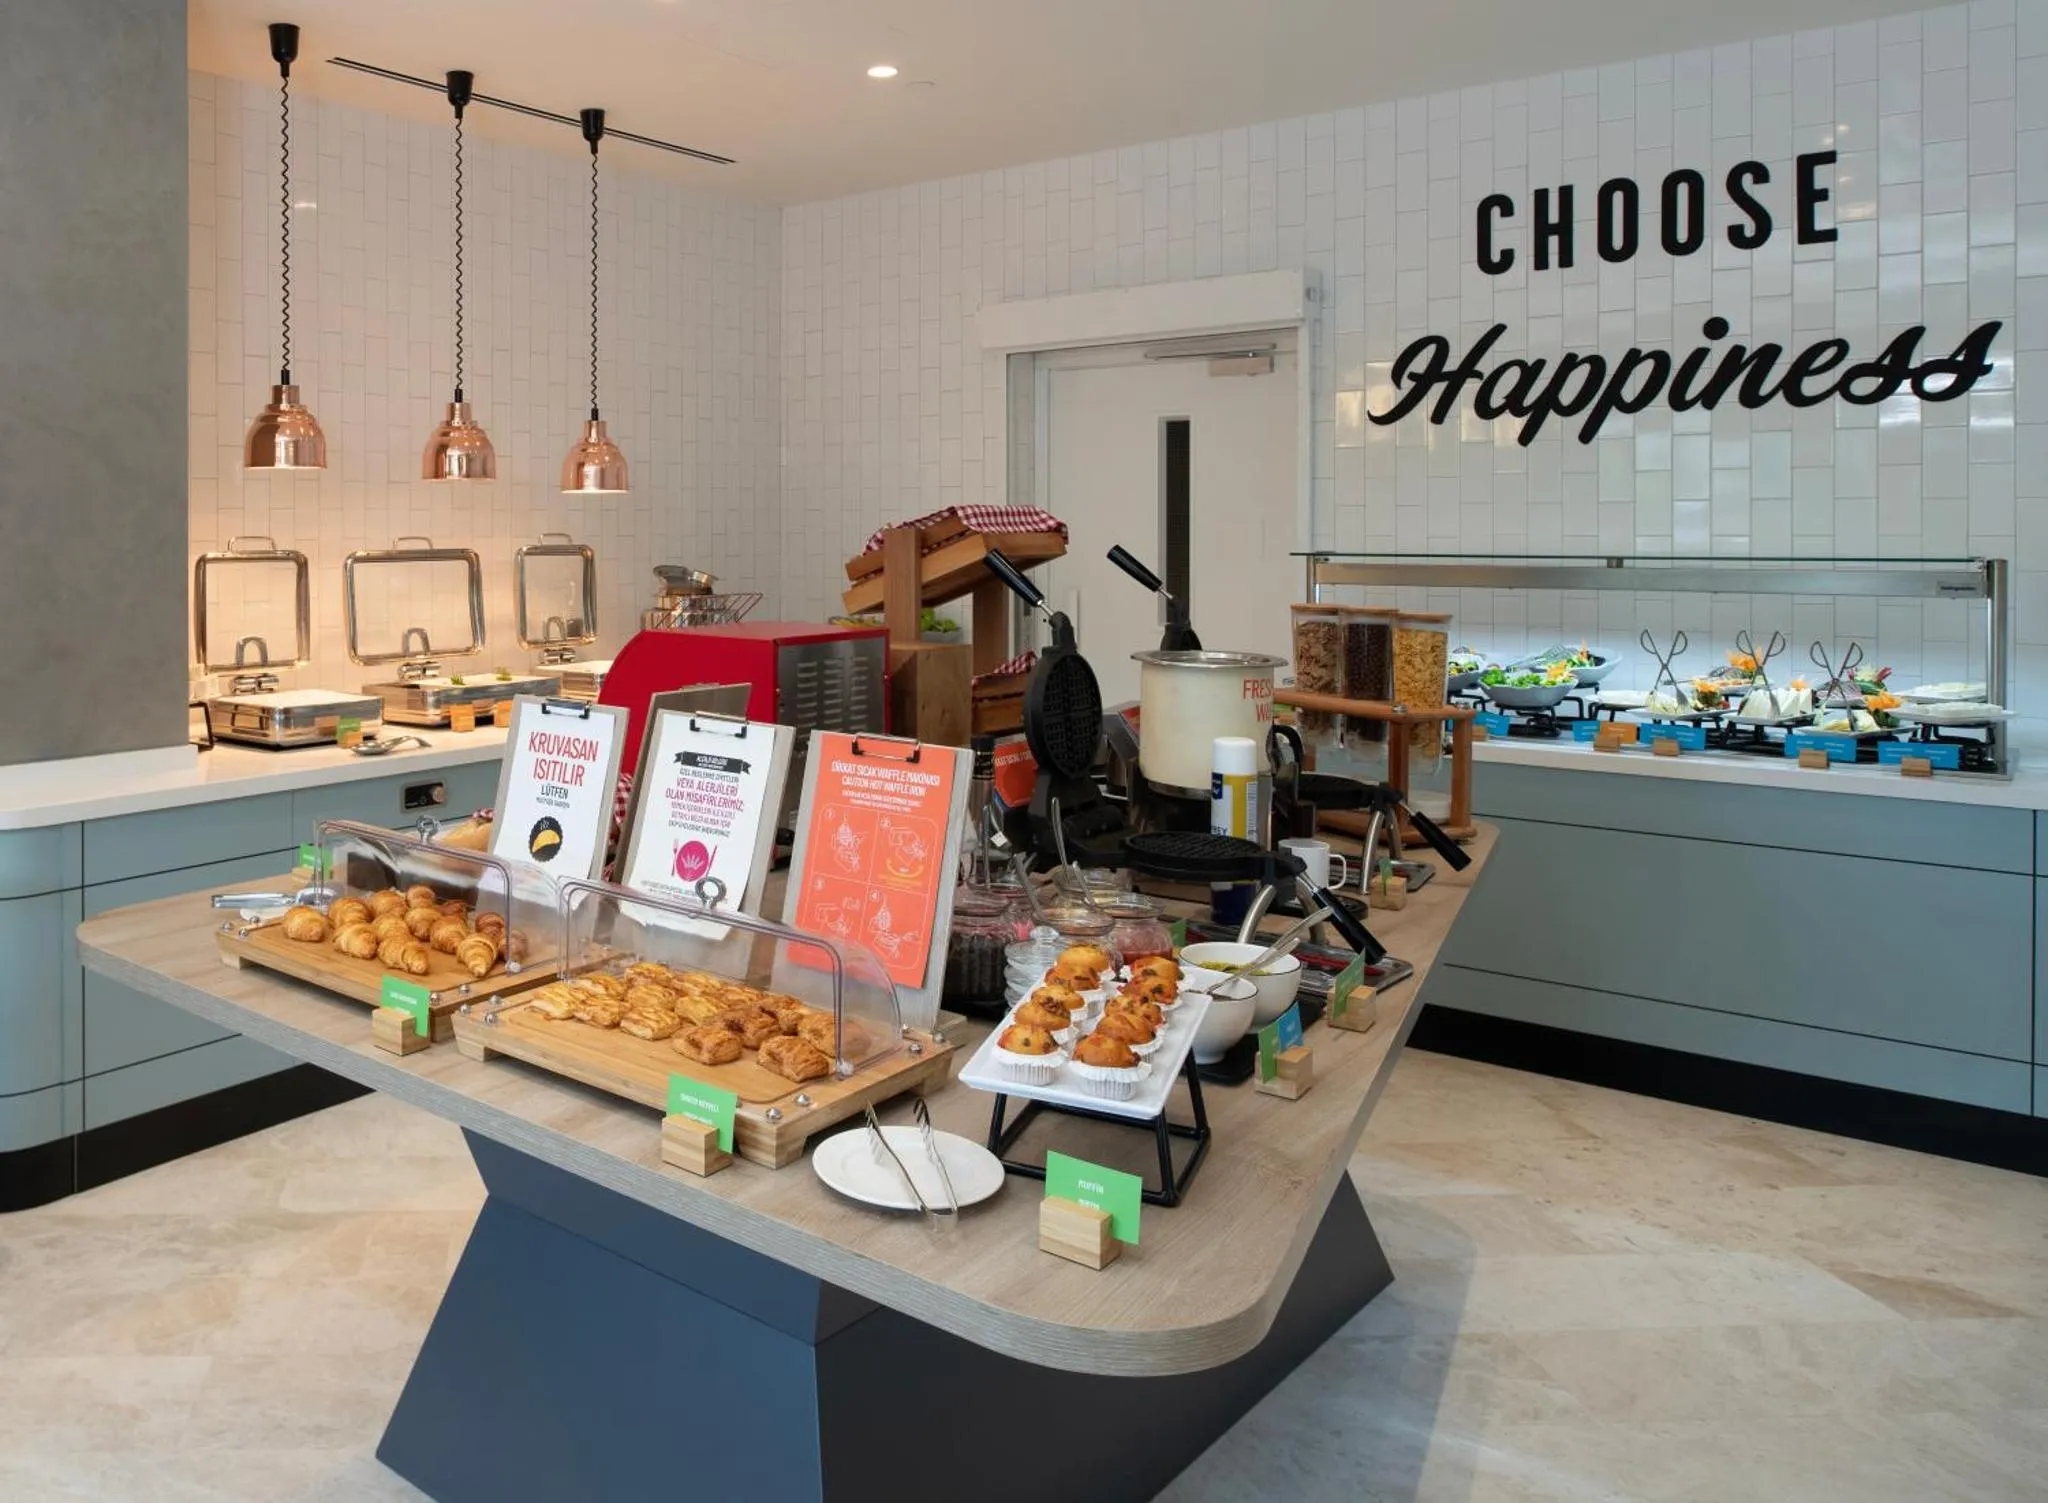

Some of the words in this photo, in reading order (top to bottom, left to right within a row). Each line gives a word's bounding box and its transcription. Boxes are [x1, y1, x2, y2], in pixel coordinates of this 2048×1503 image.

[1477, 150, 1838, 275] CHOOSE
[1367, 317, 2003, 447] Happiness
[528, 731, 599, 762] KRUVASAN
[841, 776, 869, 789] CAUTION
[869, 779, 882, 791] HOT
[883, 781, 910, 794] WAFFLE
[879, 767, 905, 781] WAFFLE
[665, 788, 685, 801] OLAN
